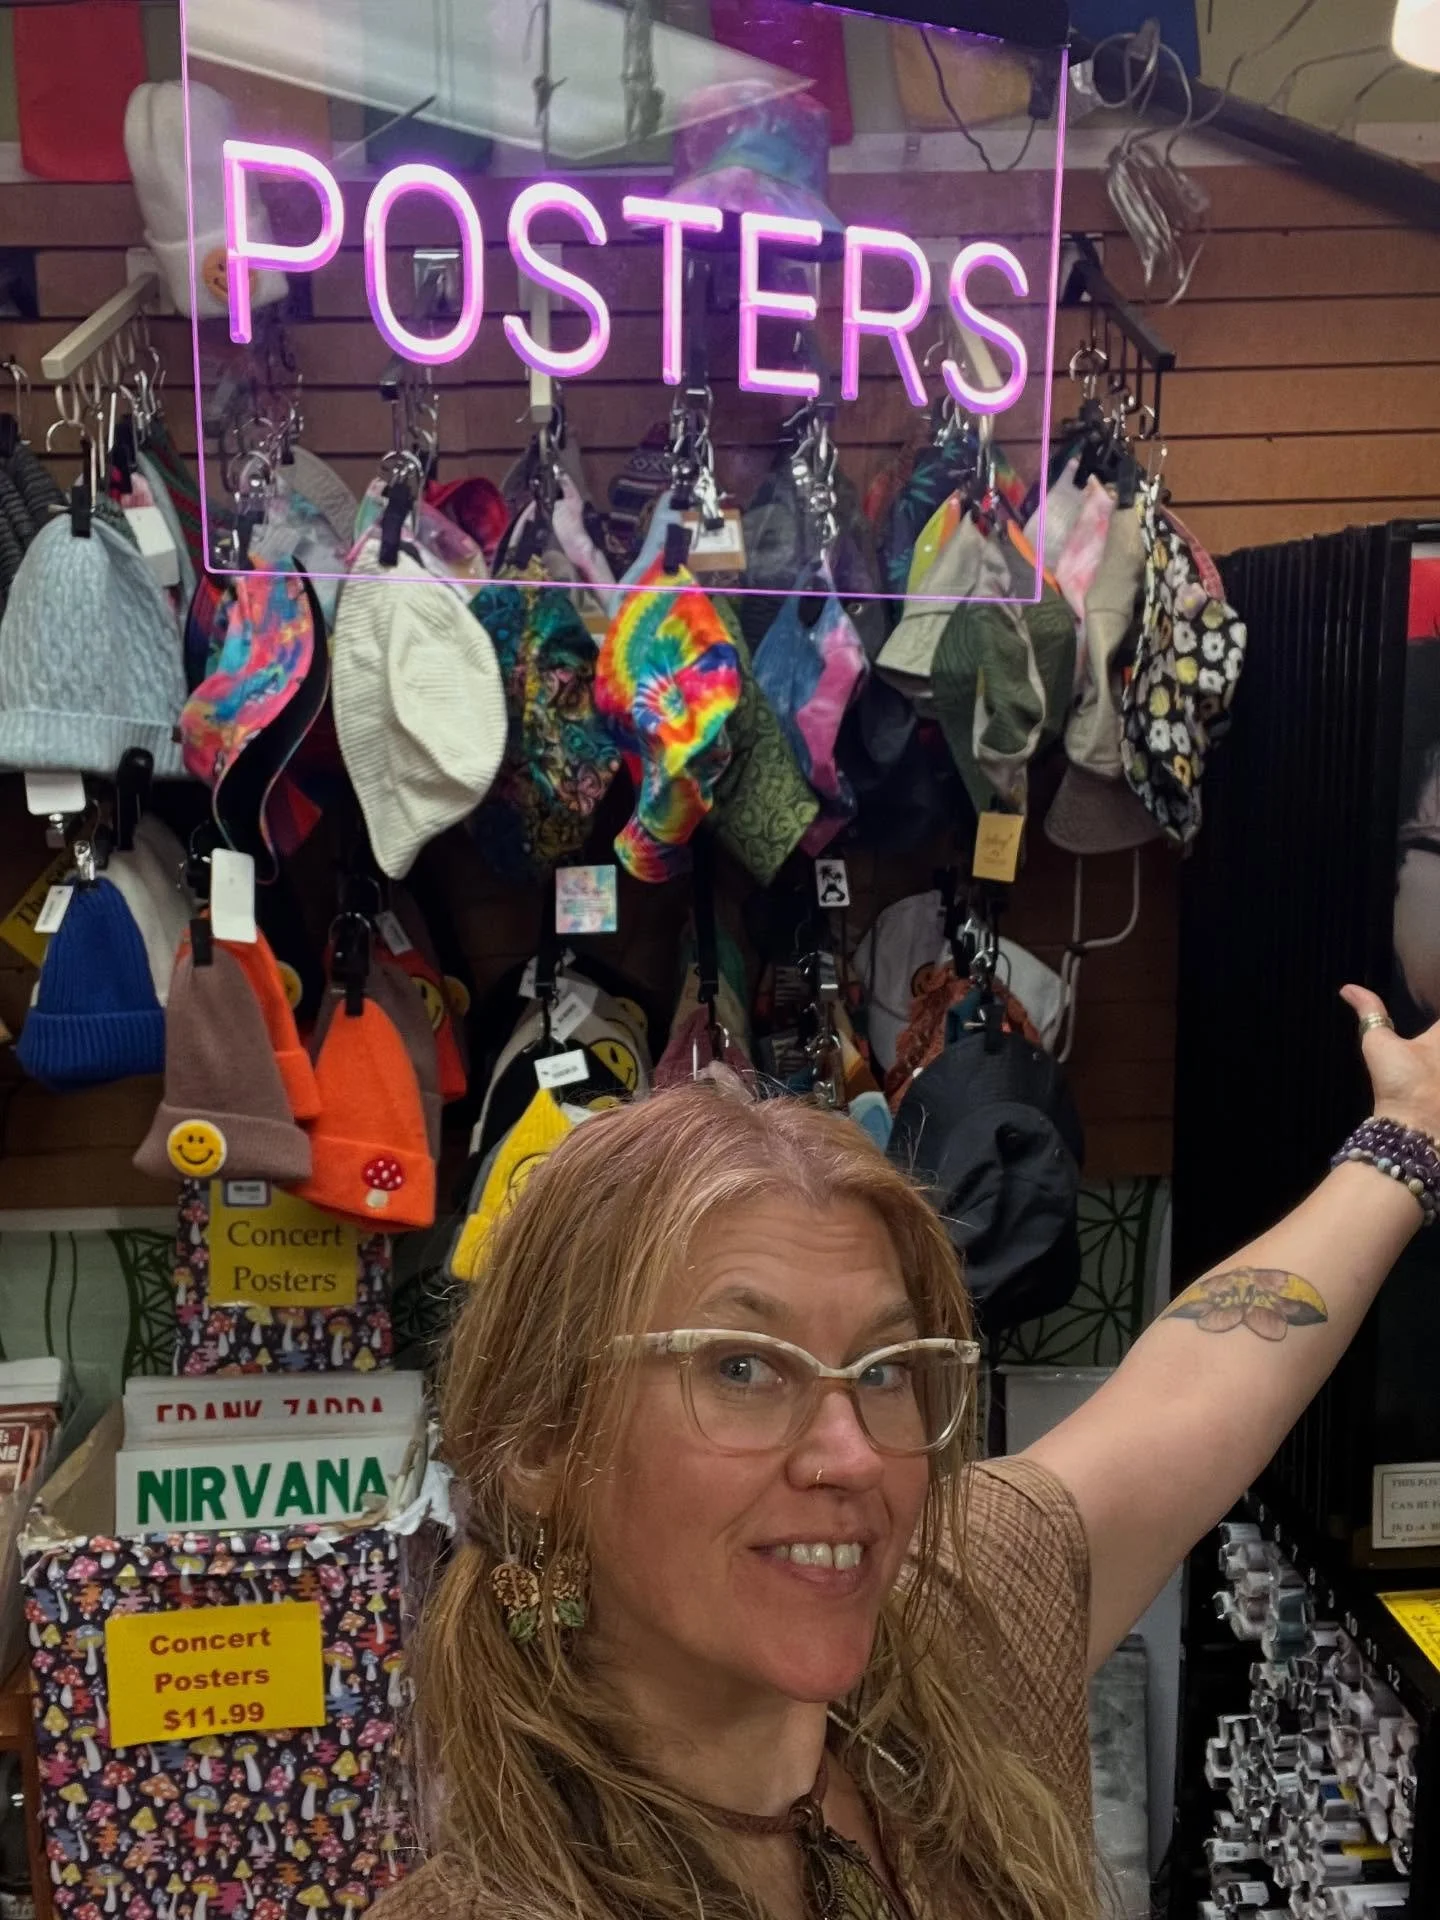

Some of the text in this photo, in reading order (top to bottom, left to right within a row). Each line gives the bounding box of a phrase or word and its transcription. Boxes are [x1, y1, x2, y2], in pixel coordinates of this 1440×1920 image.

[222, 138, 1030, 415] POSTERS
[228, 1220, 344, 1247] Concert
[233, 1265, 337, 1293] Posters
[136, 1457, 389, 1525] NIRVANA
[1345, 1610, 1358, 1637] 10
[150, 1627, 272, 1656] Concert
[1366, 1637, 1377, 1663] 11
[154, 1667, 270, 1694] Posters
[1386, 1663, 1400, 1693] 12
[163, 1702, 265, 1731] $11.99
